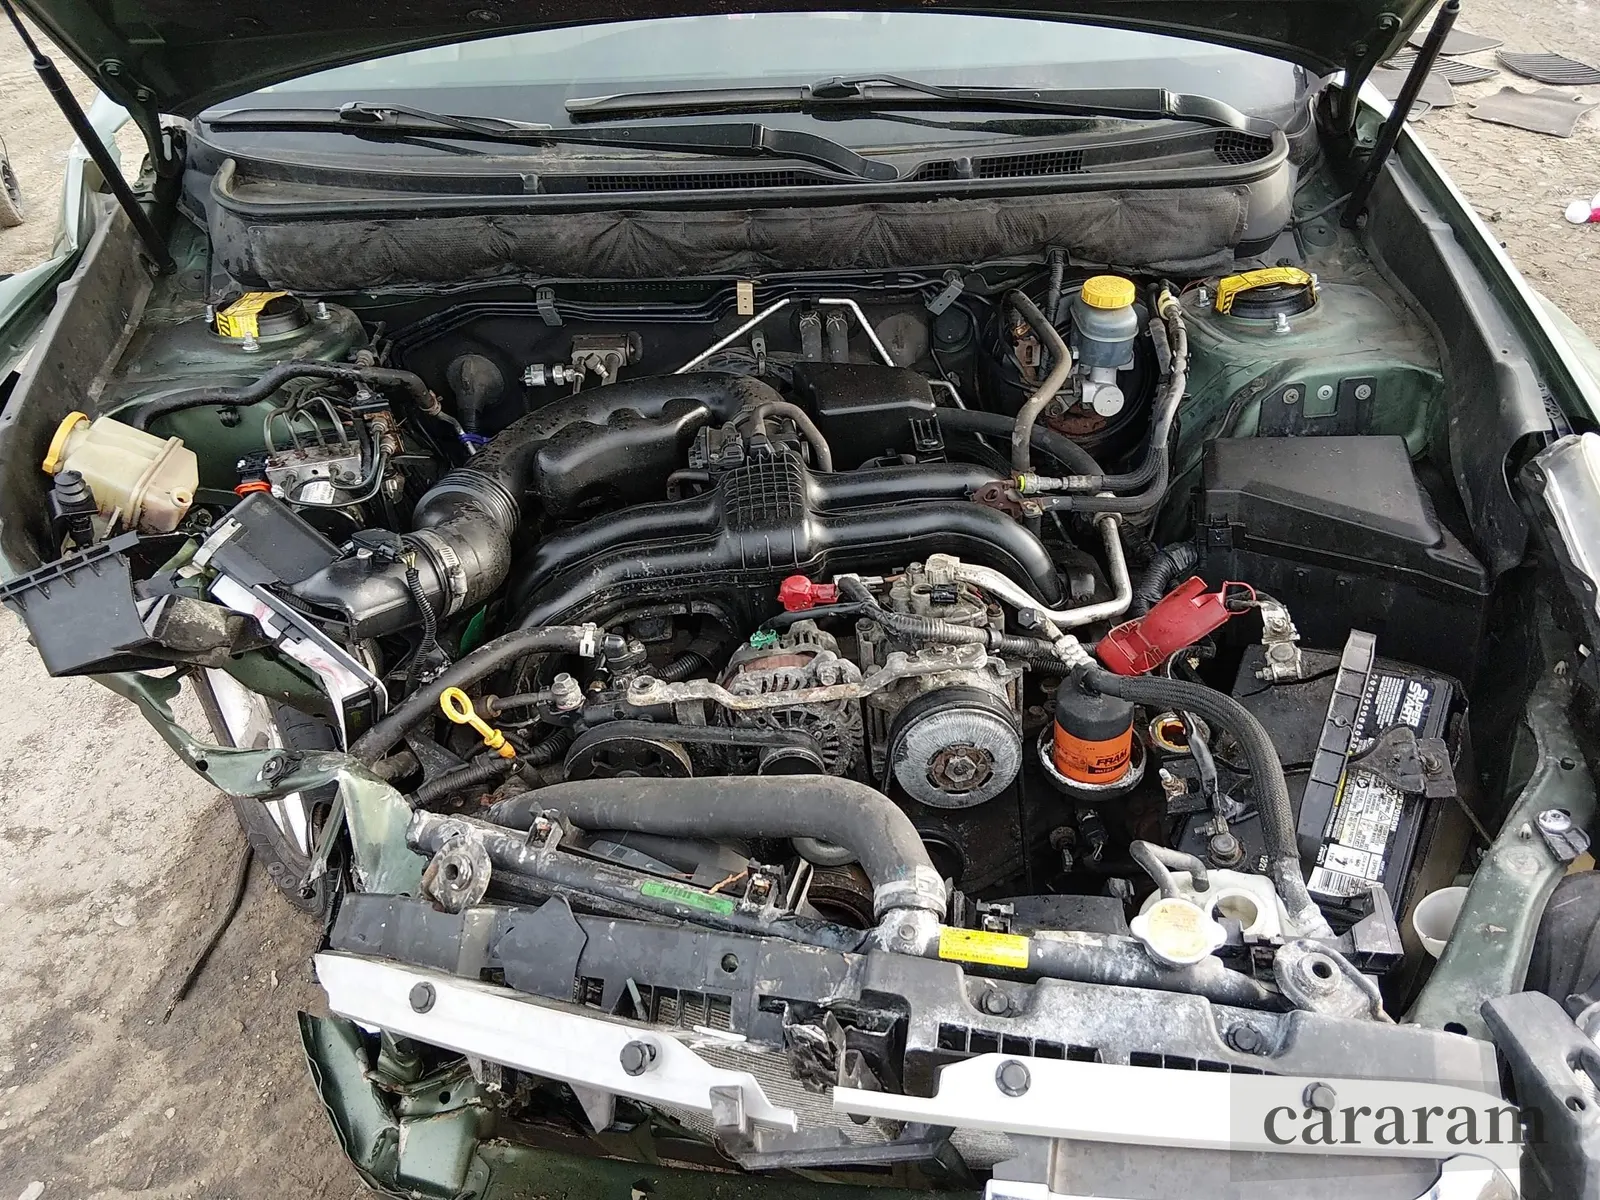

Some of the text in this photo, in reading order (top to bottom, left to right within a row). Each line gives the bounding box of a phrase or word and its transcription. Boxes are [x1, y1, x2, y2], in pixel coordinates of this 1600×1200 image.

[1401, 680, 1422, 726] START
[1409, 689, 1429, 728] SUPER
[1096, 748, 1128, 767] FRAM
